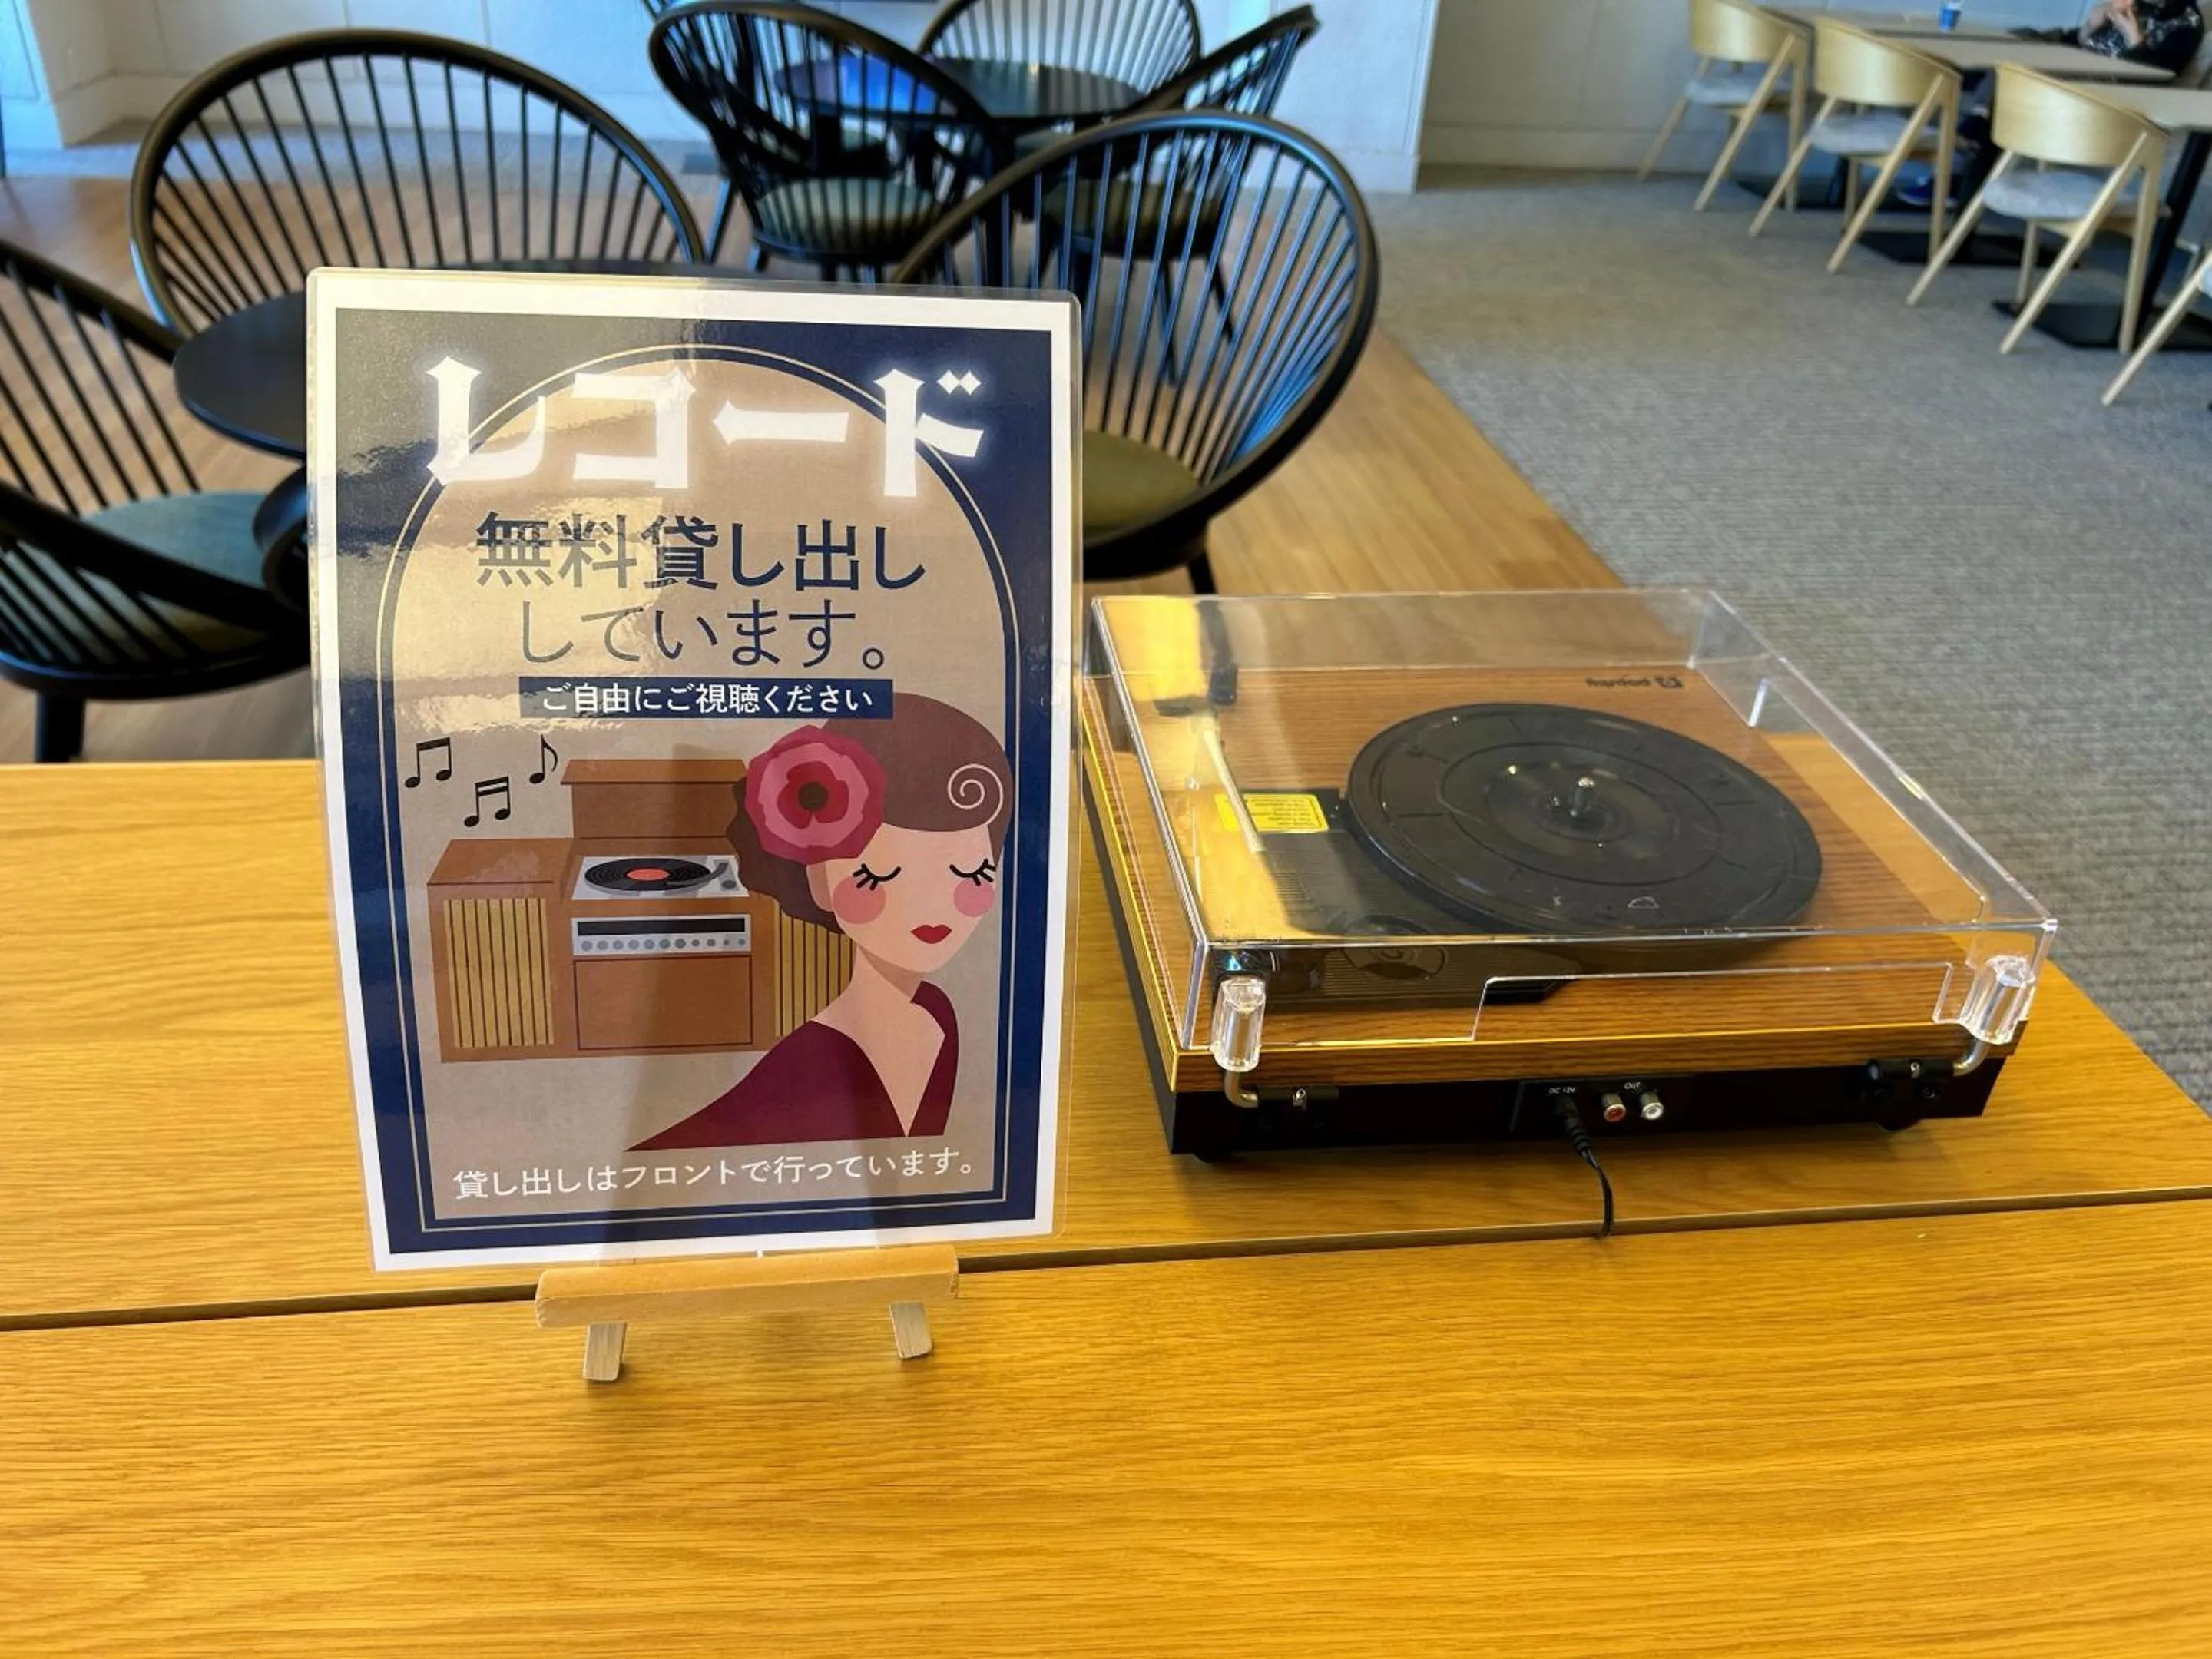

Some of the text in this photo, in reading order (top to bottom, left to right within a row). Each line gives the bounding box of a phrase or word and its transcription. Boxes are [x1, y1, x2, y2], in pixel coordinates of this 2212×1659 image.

[426, 355, 986, 498] レコード
[475, 511, 926, 591] 無料貸し出し
[520, 598, 886, 671] しています。
[542, 682, 873, 714] ご自由にご視聴ください
[452, 1147, 973, 1200] 貸し出しはフロントで行っています。
